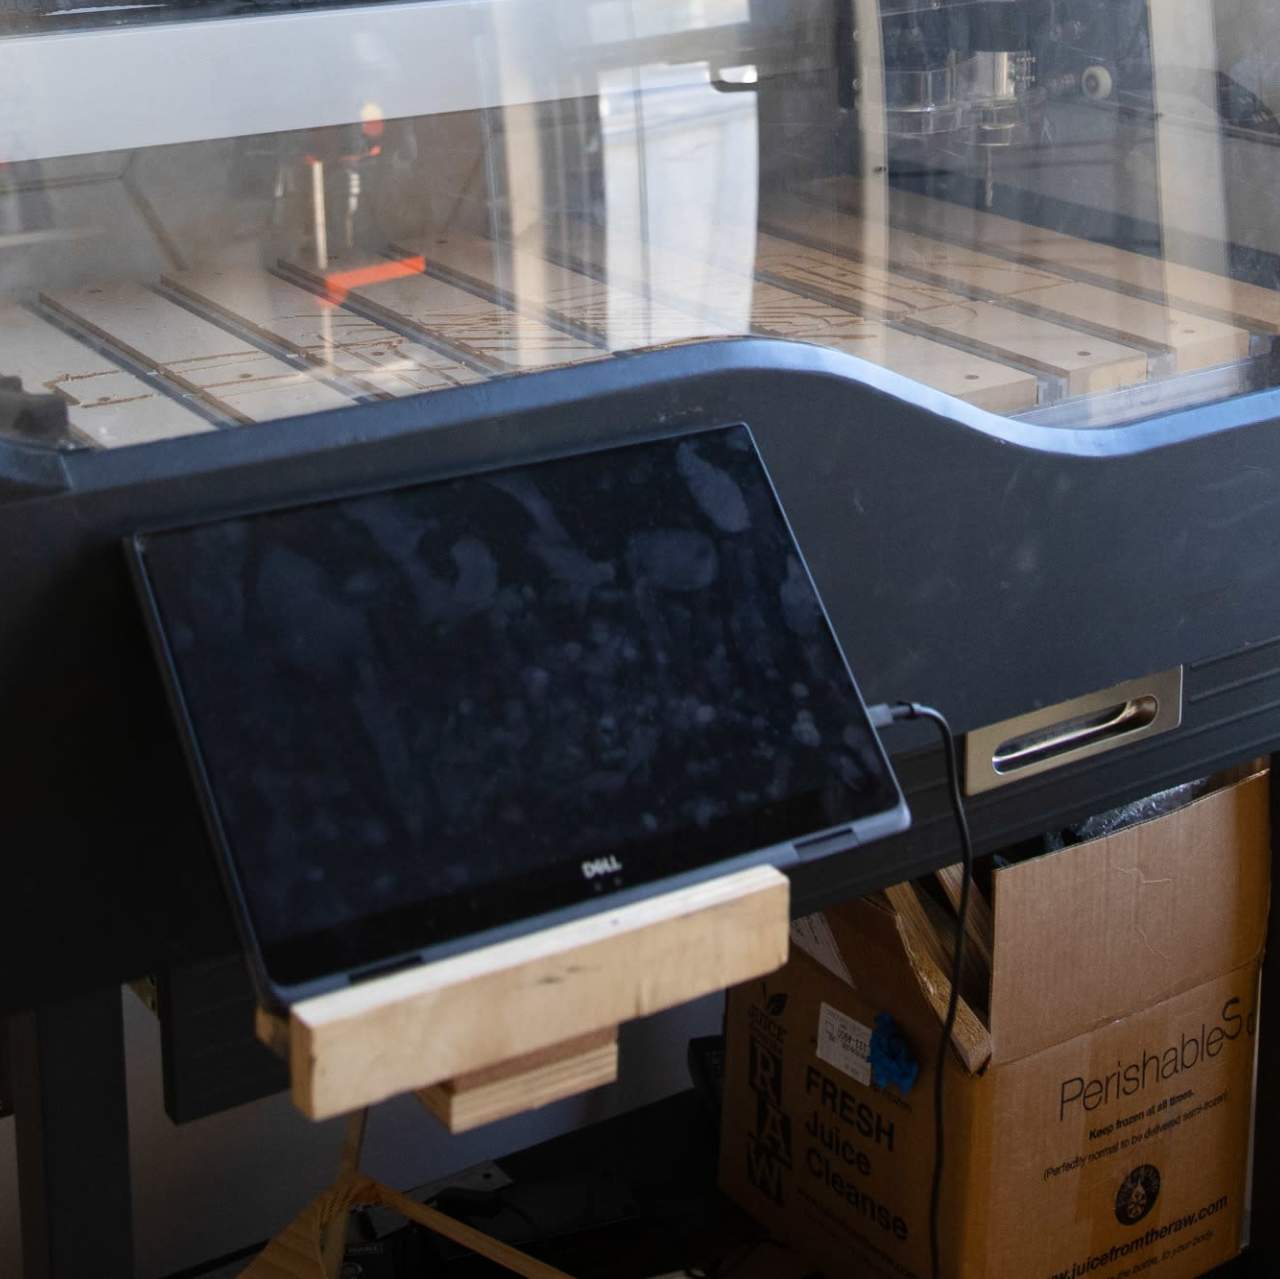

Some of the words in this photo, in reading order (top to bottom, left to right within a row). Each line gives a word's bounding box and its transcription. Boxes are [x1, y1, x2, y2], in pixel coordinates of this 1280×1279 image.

[581, 854, 622, 879] DELL
[806, 1065, 894, 1152] FRESH
[1088, 1127, 1114, 1141] Keep
[1115, 1111, 1144, 1130] frozen
[804, 1111, 870, 1176] Juice
[1087, 1141, 1119, 1162] normal
[806, 1148, 908, 1241] Cleanse
